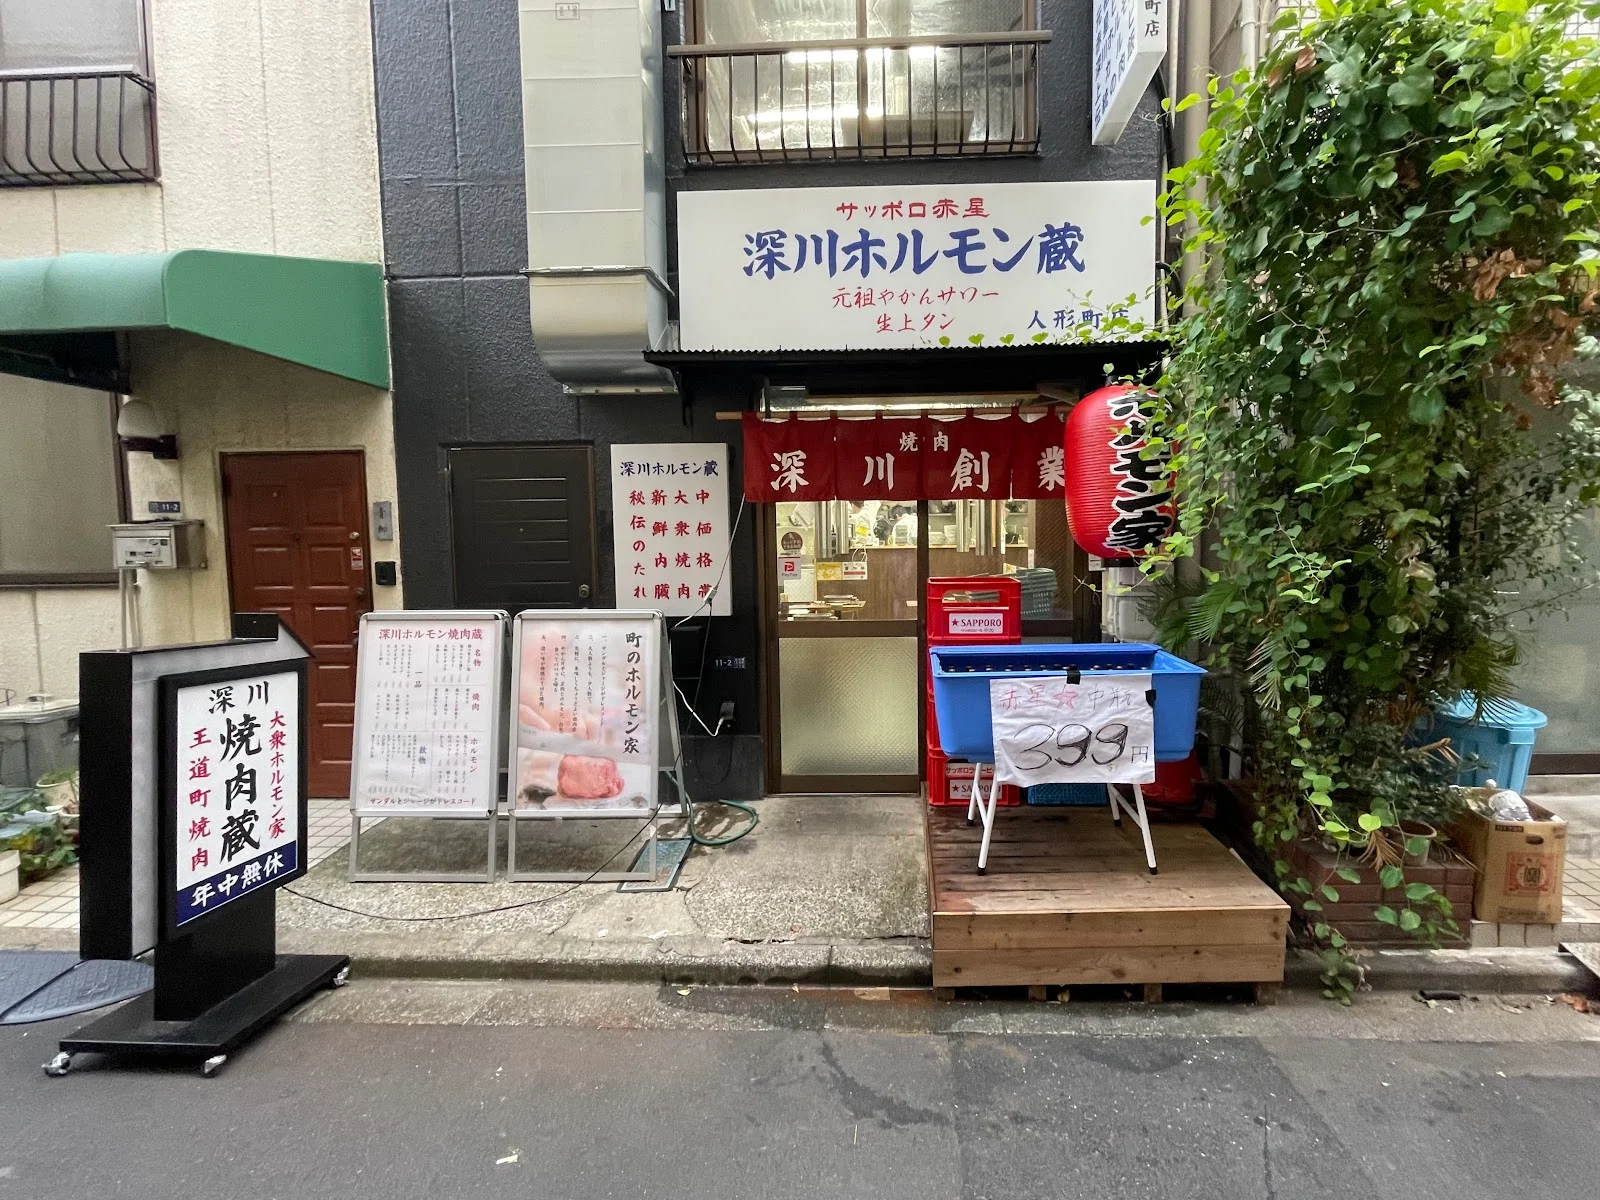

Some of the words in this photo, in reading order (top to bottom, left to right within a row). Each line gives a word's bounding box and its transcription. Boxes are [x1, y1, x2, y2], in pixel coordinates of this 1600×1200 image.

[836, 197, 990, 220] サッポロ赤星
[742, 221, 1085, 280] 深川ホルモン蔵
[832, 286, 1000, 309] 元祖やかんサワー
[876, 313, 955, 333] 生上タン
[900, 431, 949, 451] 焼肉
[620, 460, 718, 477] 深川ホルモン蔵
[770, 446, 1065, 494] 深川創業
[629, 490, 646, 599] 秘伝のたれ
[674, 490, 691, 599] 大衆焼肉
[379, 629, 483, 640] 深川ホルモン焼肉蔵
[961, 619, 1001, 627] SAPPORO
[474, 649, 481, 667] 名物
[715, 659, 732, 667] 11-2
[208, 681, 269, 714] 深川
[471, 692, 480, 711] 焼肉
[622, 632, 642, 754] 町のホルモン家
[470, 738, 478, 773] ホルモン
[219, 713, 263, 865] 焼肉蔵
[268, 711, 287, 839] 大衆ホルモン家
[188, 728, 212, 871] 王道町焼肉
[191, 851, 285, 907] 年中無休
